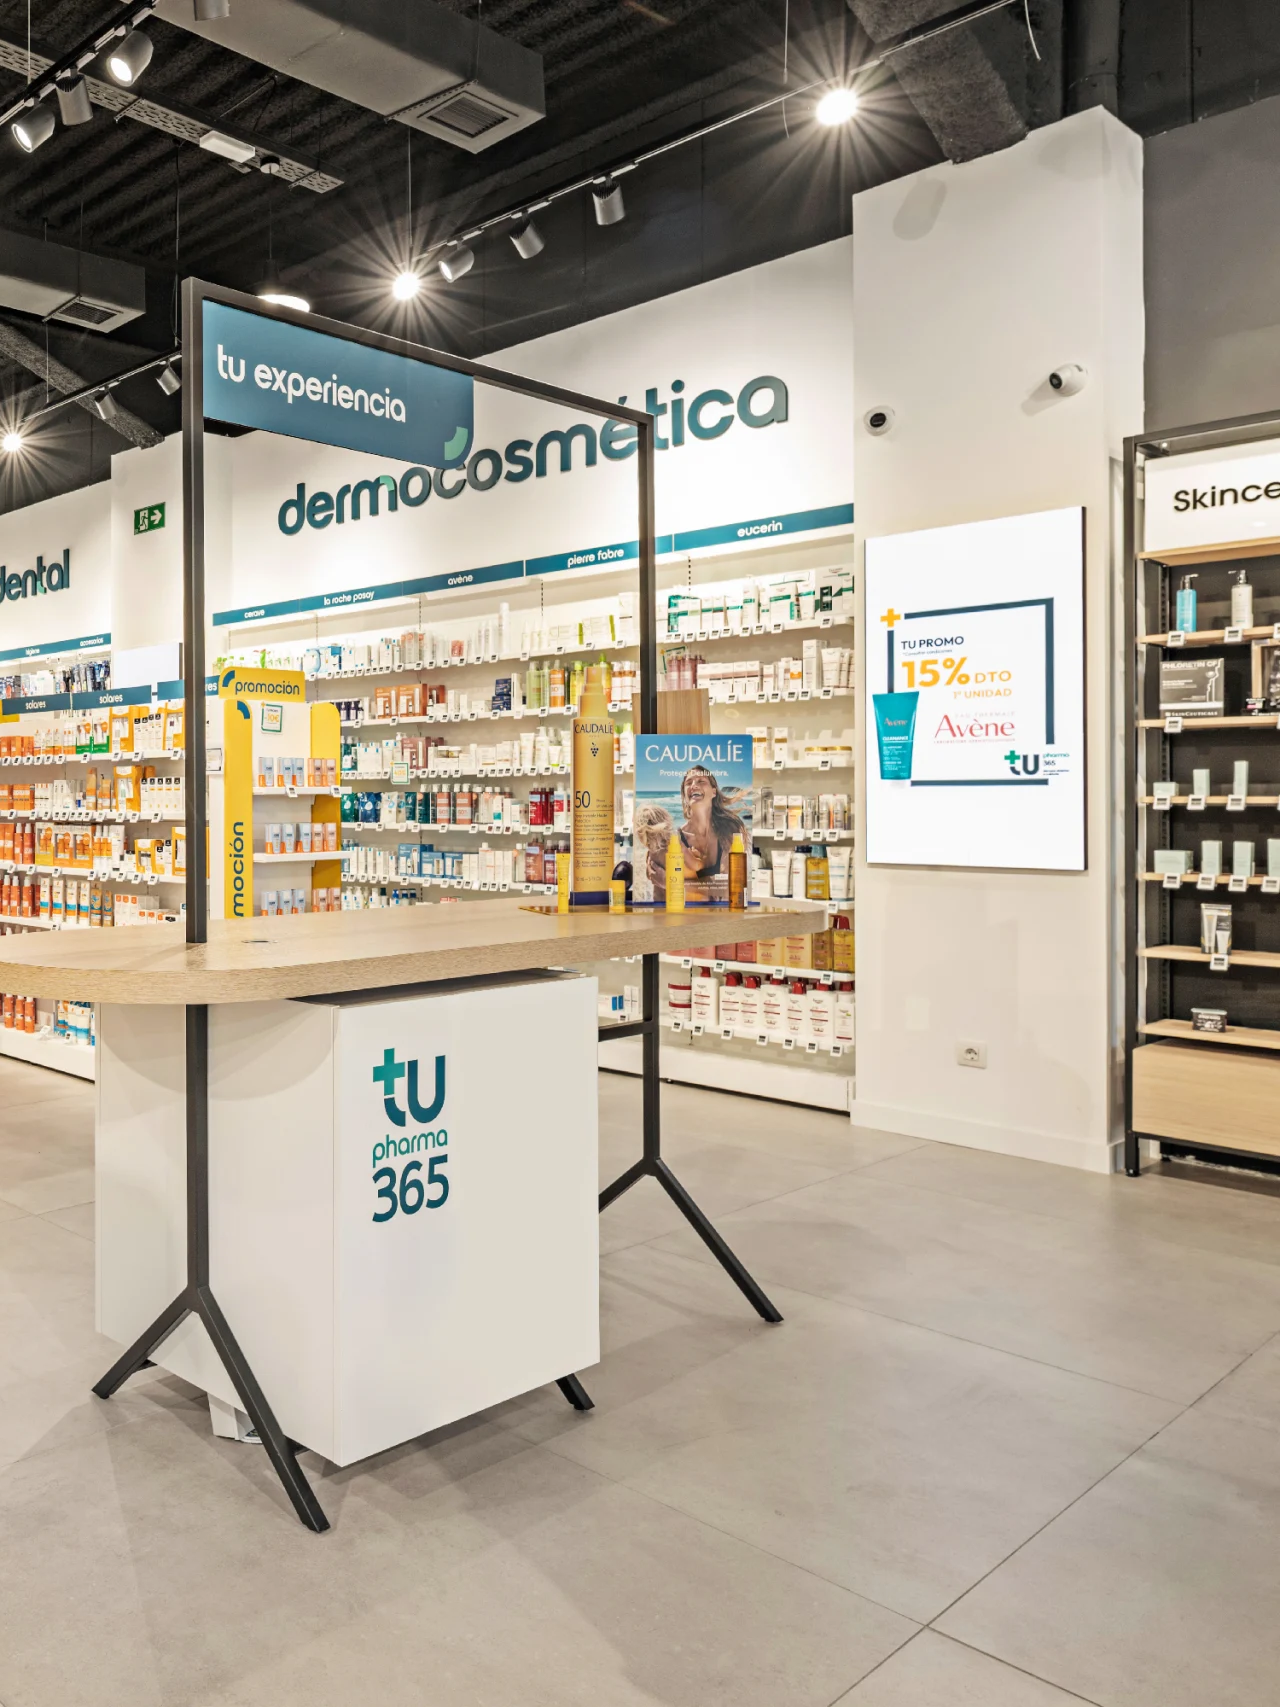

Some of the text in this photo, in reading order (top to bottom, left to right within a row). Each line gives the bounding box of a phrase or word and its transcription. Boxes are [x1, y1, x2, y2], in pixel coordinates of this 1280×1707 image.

[217, 343, 406, 423] tu experiencia
[277, 374, 790, 536] dermocosmética
[737, 520, 783, 538] eucerin
[567, 547, 624, 568] pierre fabre
[447, 573, 473, 586] avène
[323, 590, 375, 605] la roche posay
[244, 608, 265, 618] cerave
[901, 636, 965, 650] TU PROMO
[901, 656, 1012, 689] 15% DTO
[234, 680, 300, 696] promoción
[964, 688, 1012, 699] UNIDAD
[25, 700, 47, 710] solares
[99, 694, 124, 705] solares
[574, 721, 614, 735] CAUDALÍE
[934, 714, 1016, 738] Avène
[645, 739, 744, 763] CAUDALÍE
[1003, 750, 1040, 776] tu
[575, 790, 591, 809] 50
[229, 821, 245, 918] moción
[372, 1047, 446, 1128] tu
[372, 1128, 448, 1169] pharma
[372, 1153, 450, 1223] 365
